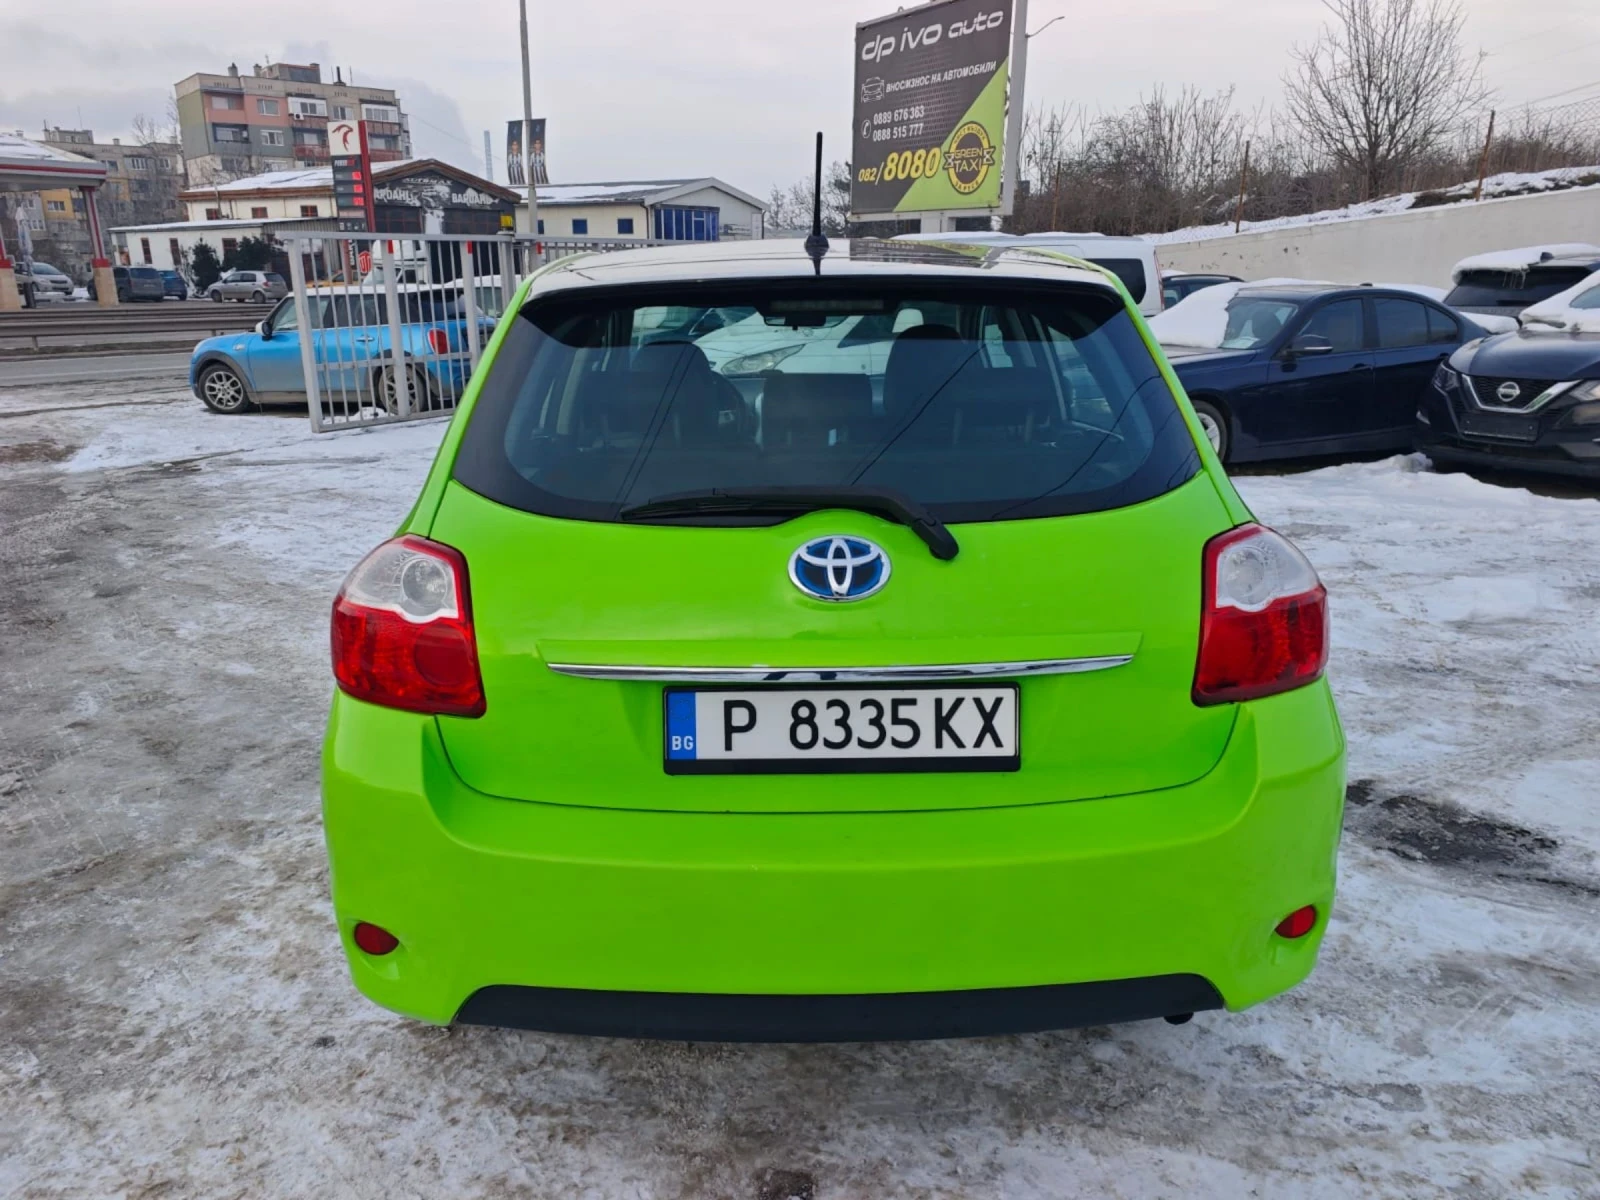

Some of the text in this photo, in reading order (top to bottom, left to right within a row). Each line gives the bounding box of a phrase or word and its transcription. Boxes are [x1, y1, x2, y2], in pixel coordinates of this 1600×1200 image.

[861, 10, 1004, 63] dp ivo auto
[930, 73, 941, 84] НА
[942, 60, 997, 81] АВТОМОБИЛИ
[873, 111, 892, 125] 0889
[894, 108, 908, 122] 676
[892, 125, 907, 139] 515
[909, 123, 924, 137] 777
[955, 147, 983, 159] GREEN
[954, 158, 982, 172] TAXI
[723, 699, 757, 752] P
[671, 735, 694, 751] BG
